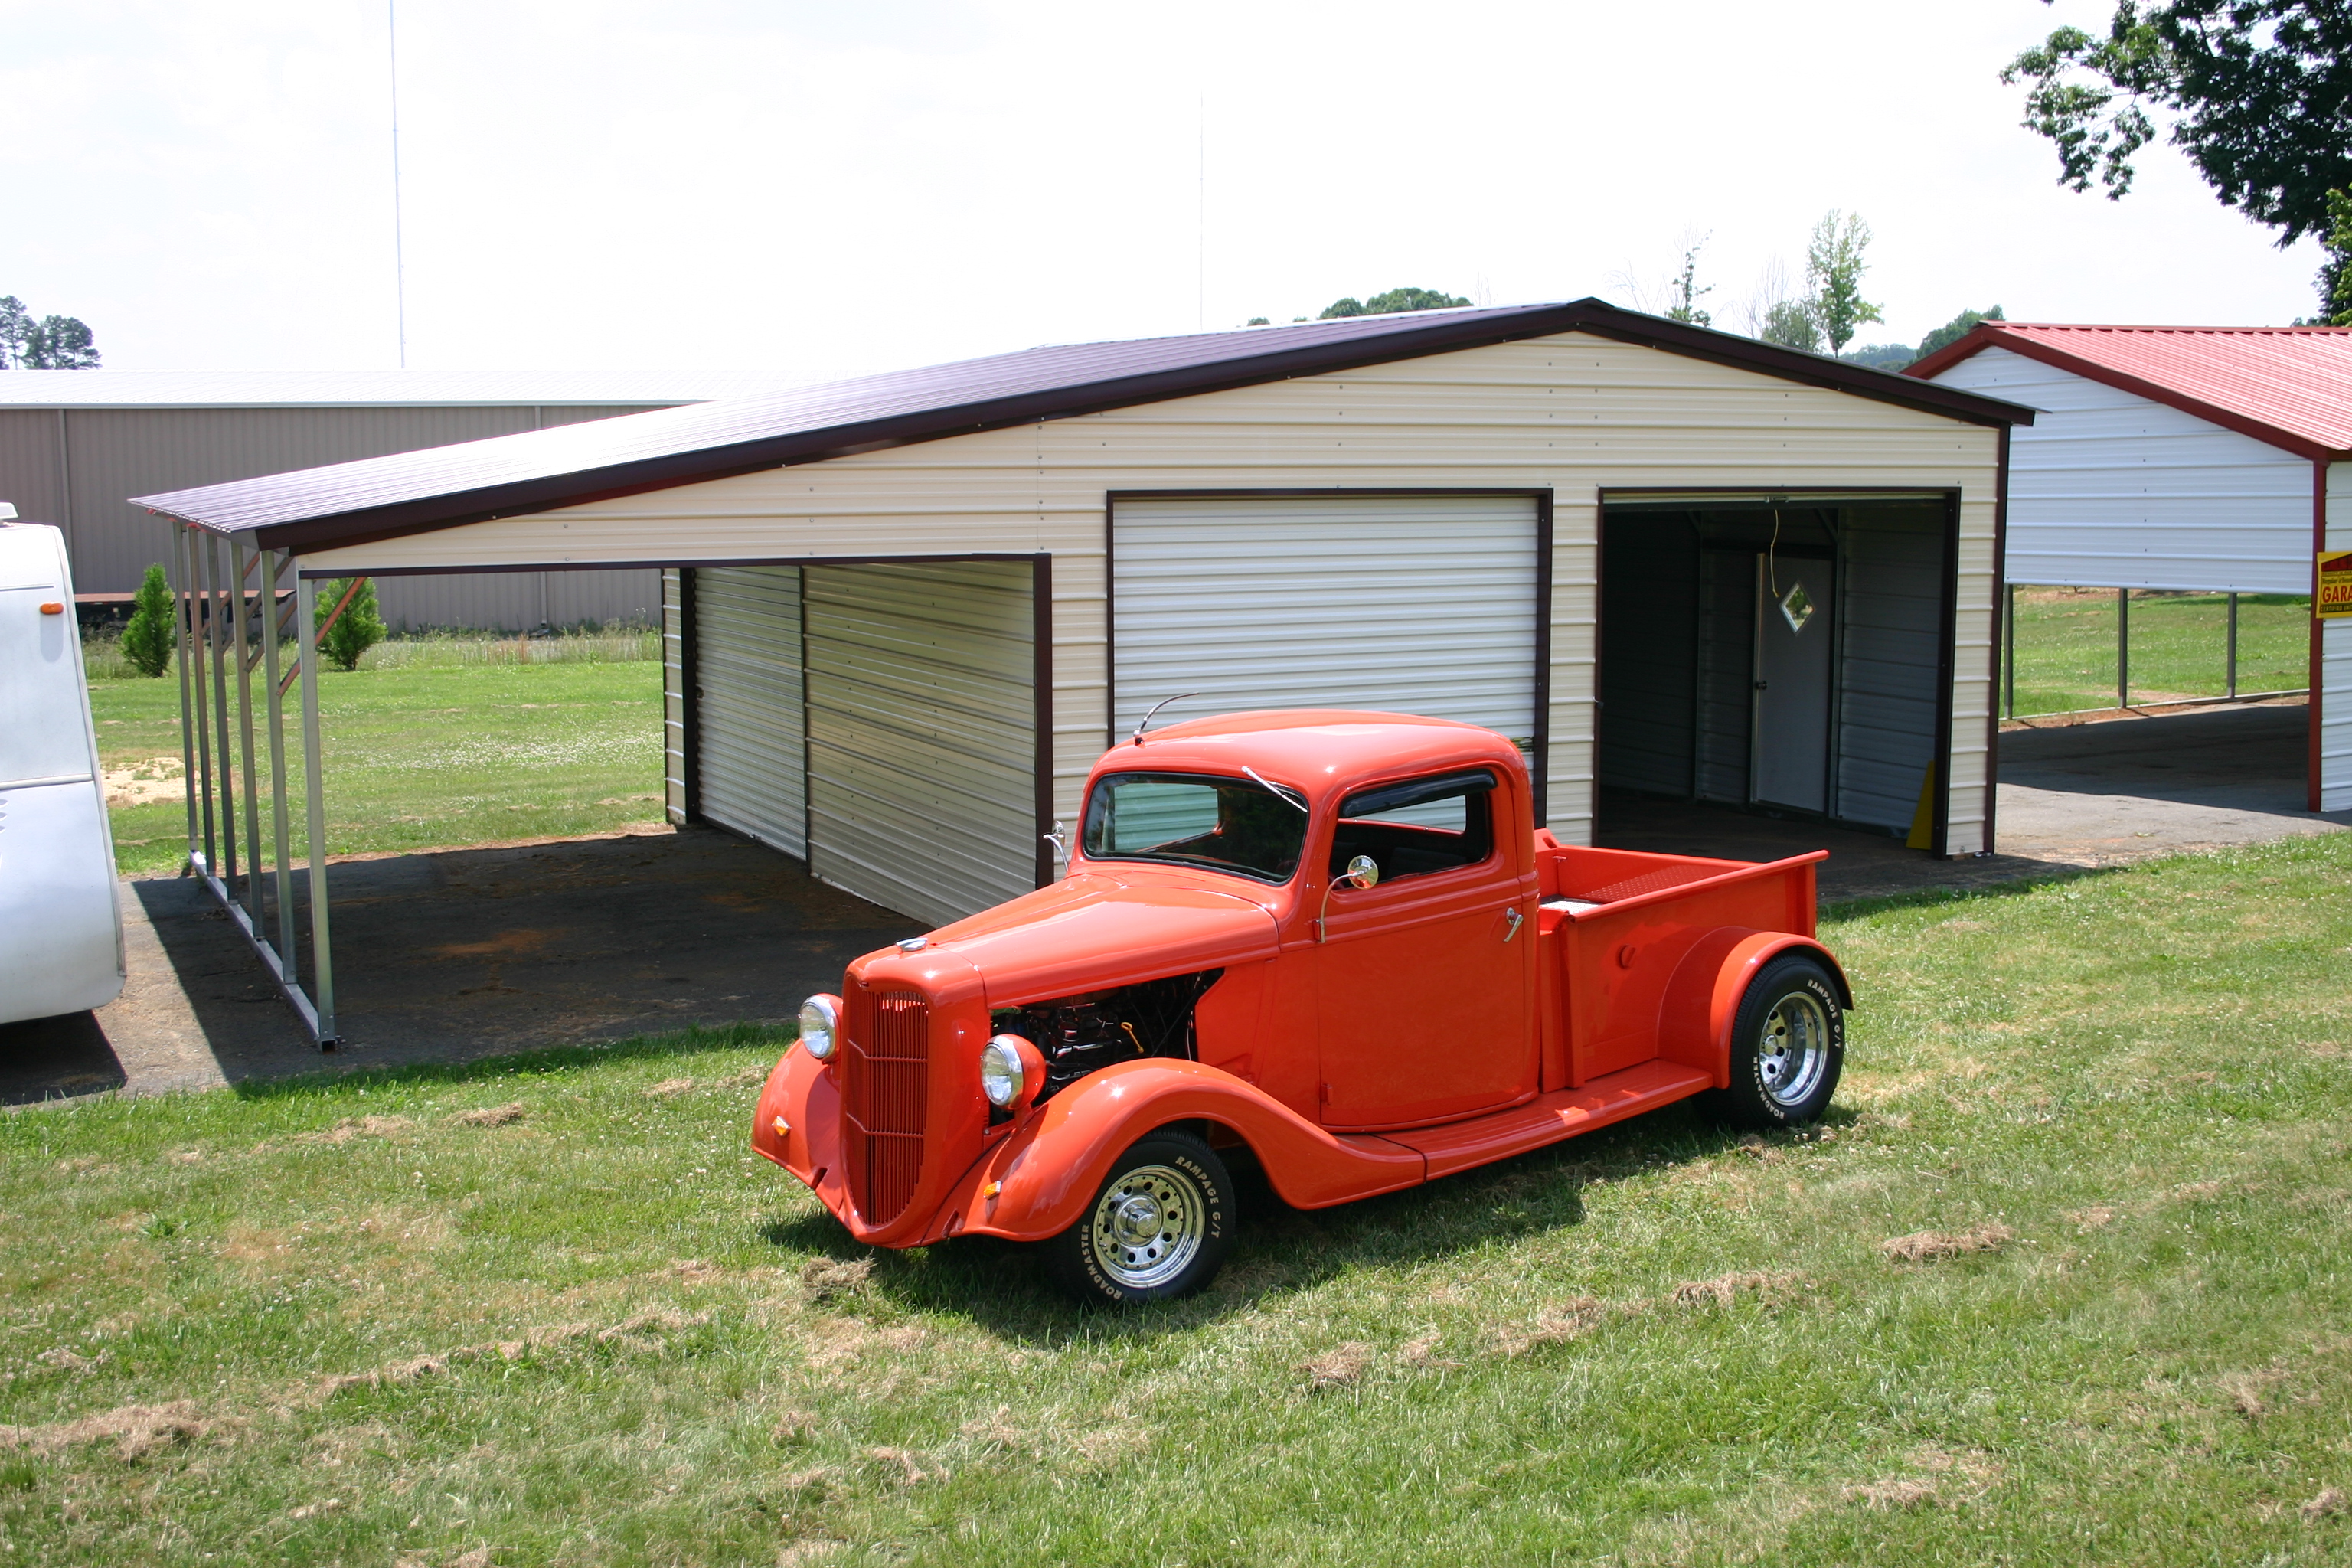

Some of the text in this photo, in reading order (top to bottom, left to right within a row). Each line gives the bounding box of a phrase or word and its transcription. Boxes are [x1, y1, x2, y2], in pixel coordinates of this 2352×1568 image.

[1807, 979, 1838, 1019] RAMPAGE
[1753, 1057, 1785, 1119] ROADMASTER
[1175, 1156, 1222, 1239] RAMPAGE G/T
[1080, 1225, 1123, 1300] ROADMASTER
